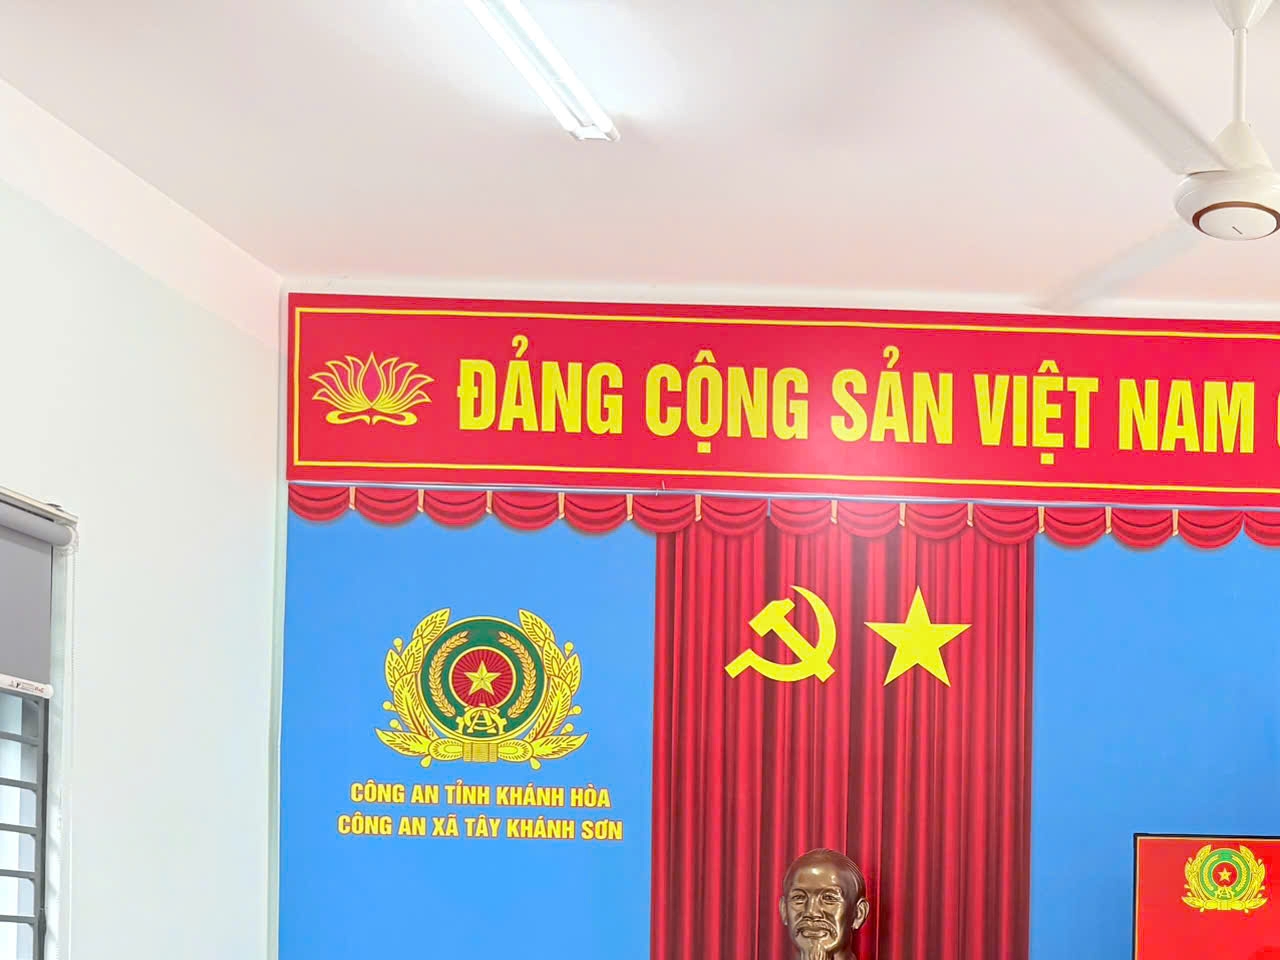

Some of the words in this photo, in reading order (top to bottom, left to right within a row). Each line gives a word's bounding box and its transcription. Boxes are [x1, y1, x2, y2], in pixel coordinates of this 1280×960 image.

[458, 334, 624, 434] ĐẢNG
[645, 350, 809, 453] CỘNG
[831, 344, 954, 445] SẢN
[974, 359, 1098, 466] VIỆT
[1119, 379, 1255, 455] NAM
[350, 778, 406, 804] CÔNG
[411, 783, 439, 804] AN
[445, 778, 490, 805] TỈNH
[496, 783, 564, 807] KHÁNH
[571, 784, 611, 808] HÒA
[337, 811, 392, 835] CÔNG
[398, 816, 426, 836] AN
[432, 814, 459, 837] XÃ
[464, 814, 501, 838] TÂY
[506, 815, 575, 839] KHÁNH
[581, 819, 623, 840] SƠN
